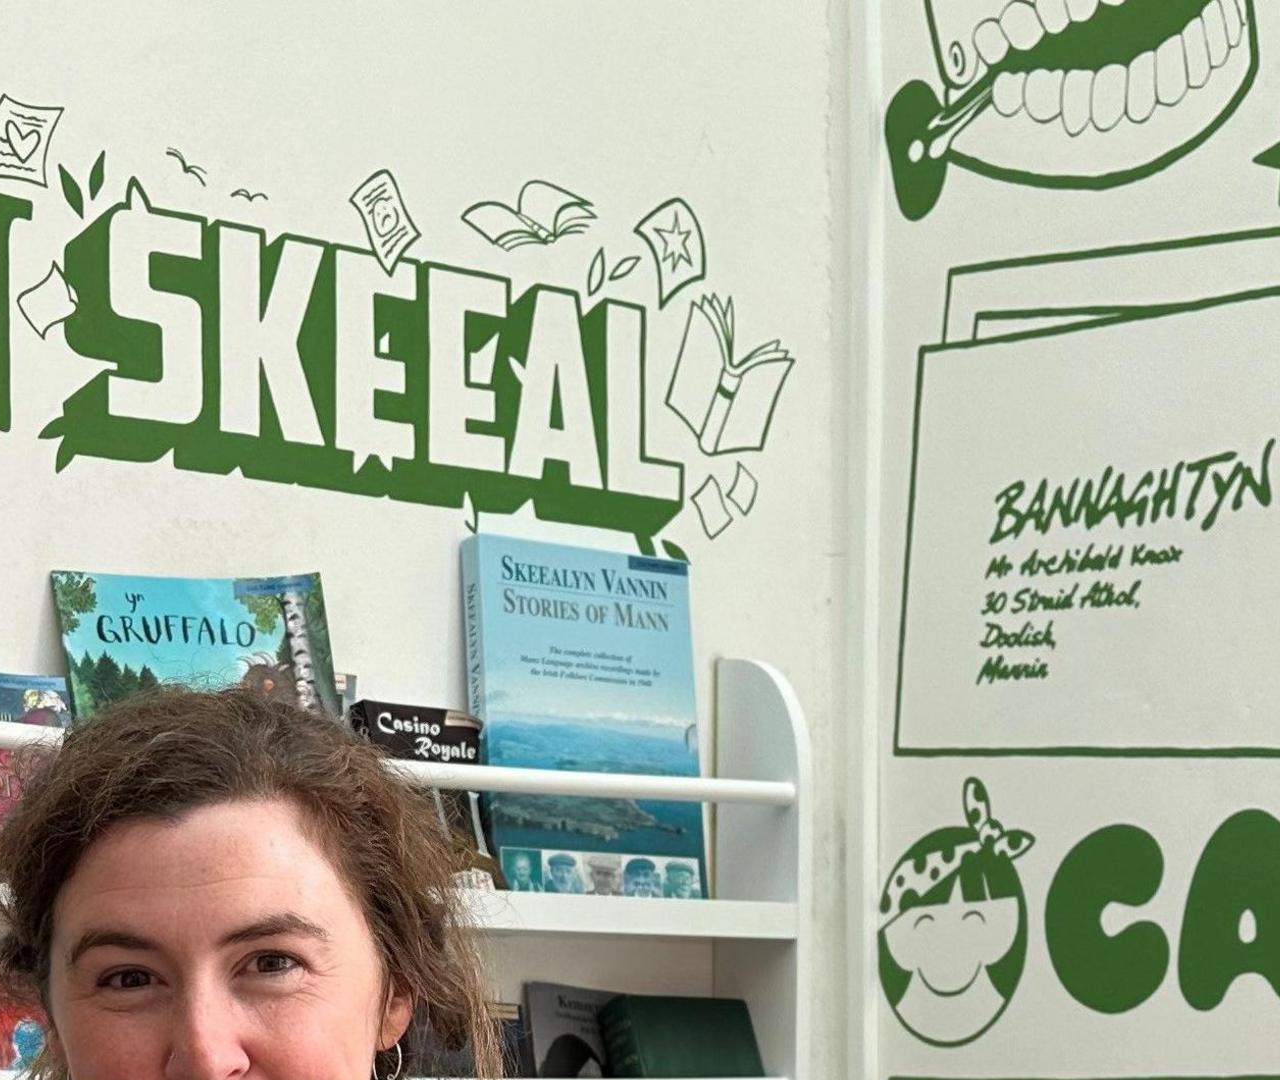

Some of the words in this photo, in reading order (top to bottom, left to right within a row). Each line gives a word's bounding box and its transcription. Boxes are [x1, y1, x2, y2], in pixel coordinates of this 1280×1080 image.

[65, 180, 686, 525] SKEEAL
[988, 438, 1276, 545] BANNAGHTYN
[1020, 543, 1123, 577] Archibald
[1130, 544, 1183, 566] Knox
[125, 592, 145, 613] yn
[981, 591, 1007, 615] 30
[1011, 583, 1078, 614] Straid
[96, 614, 256, 647] GRUFFALO
[377, 712, 441, 736] Casino
[414, 736, 477, 762] Royale
